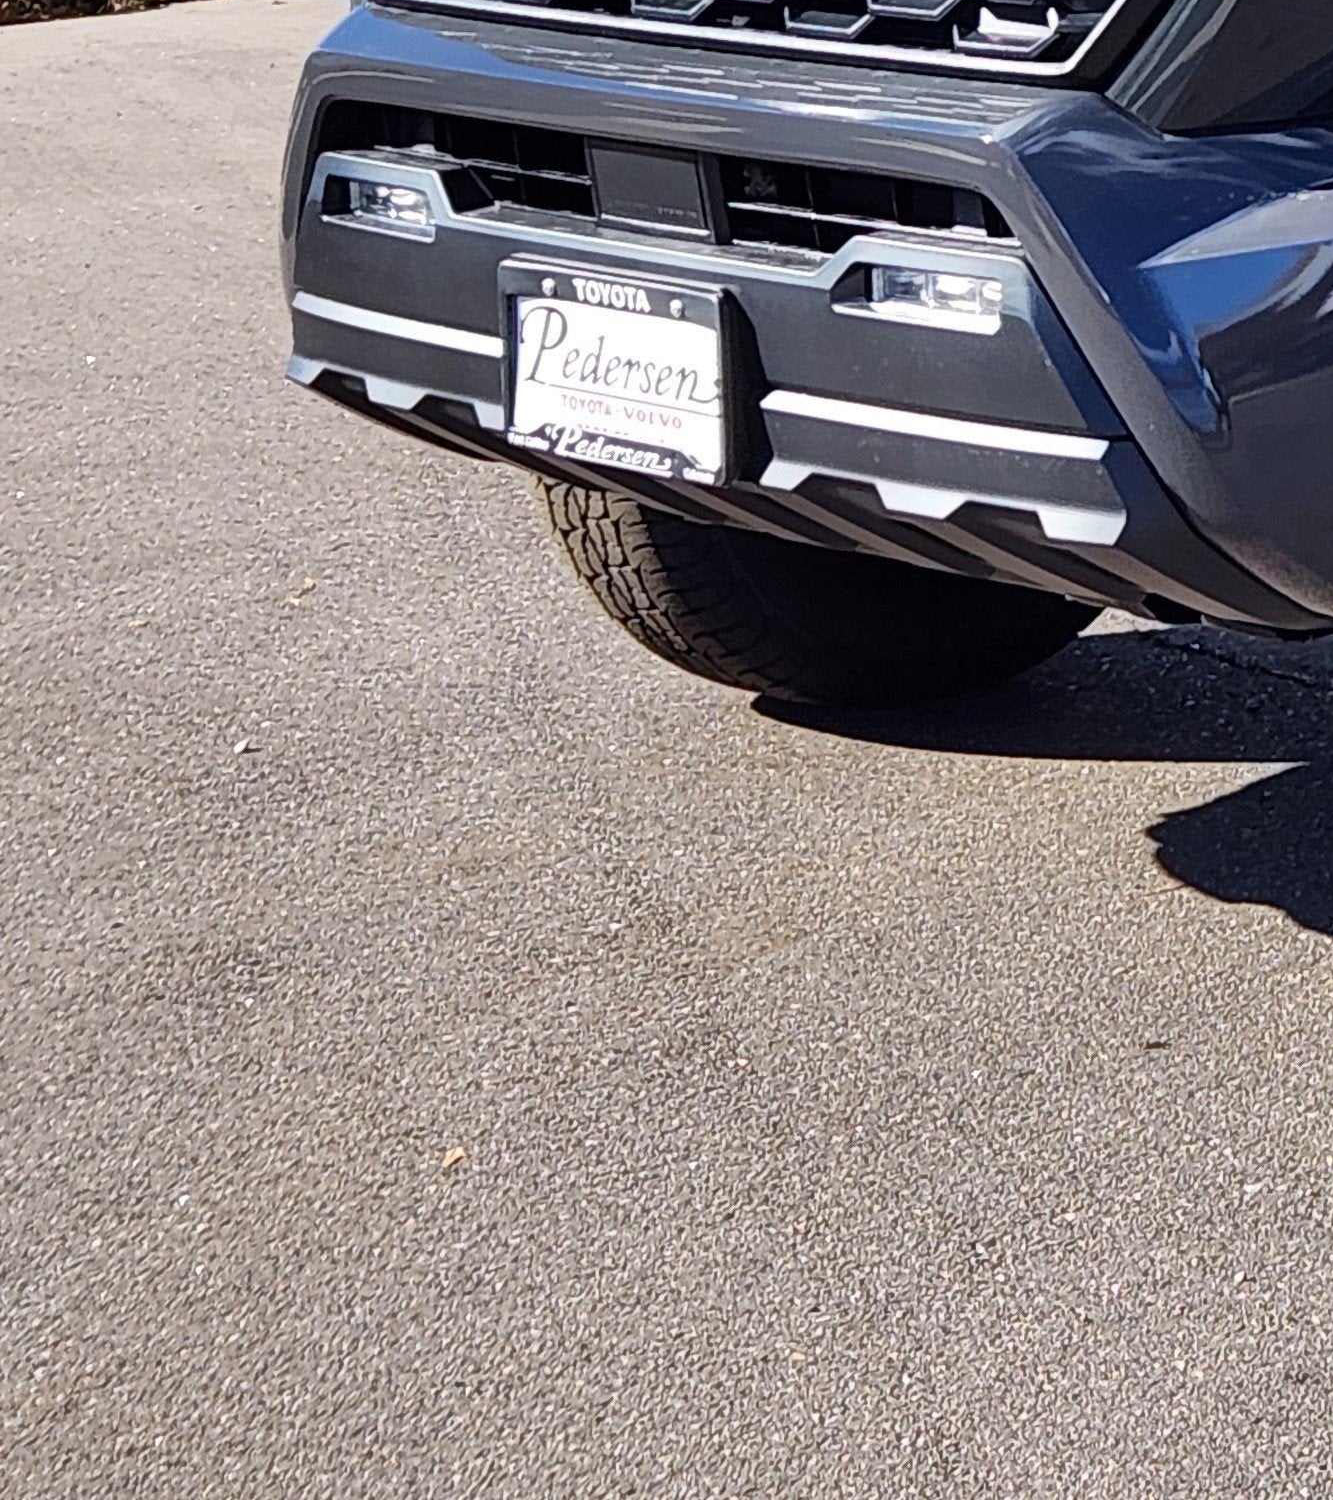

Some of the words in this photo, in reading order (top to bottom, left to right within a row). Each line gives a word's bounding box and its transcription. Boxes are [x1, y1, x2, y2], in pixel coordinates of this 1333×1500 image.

[572, 277, 652, 313] TOYOTA
[519, 305, 722, 404] Pedersen
[561, 394, 612, 415] TOYOTA
[544, 422, 673, 471] Pedersen
